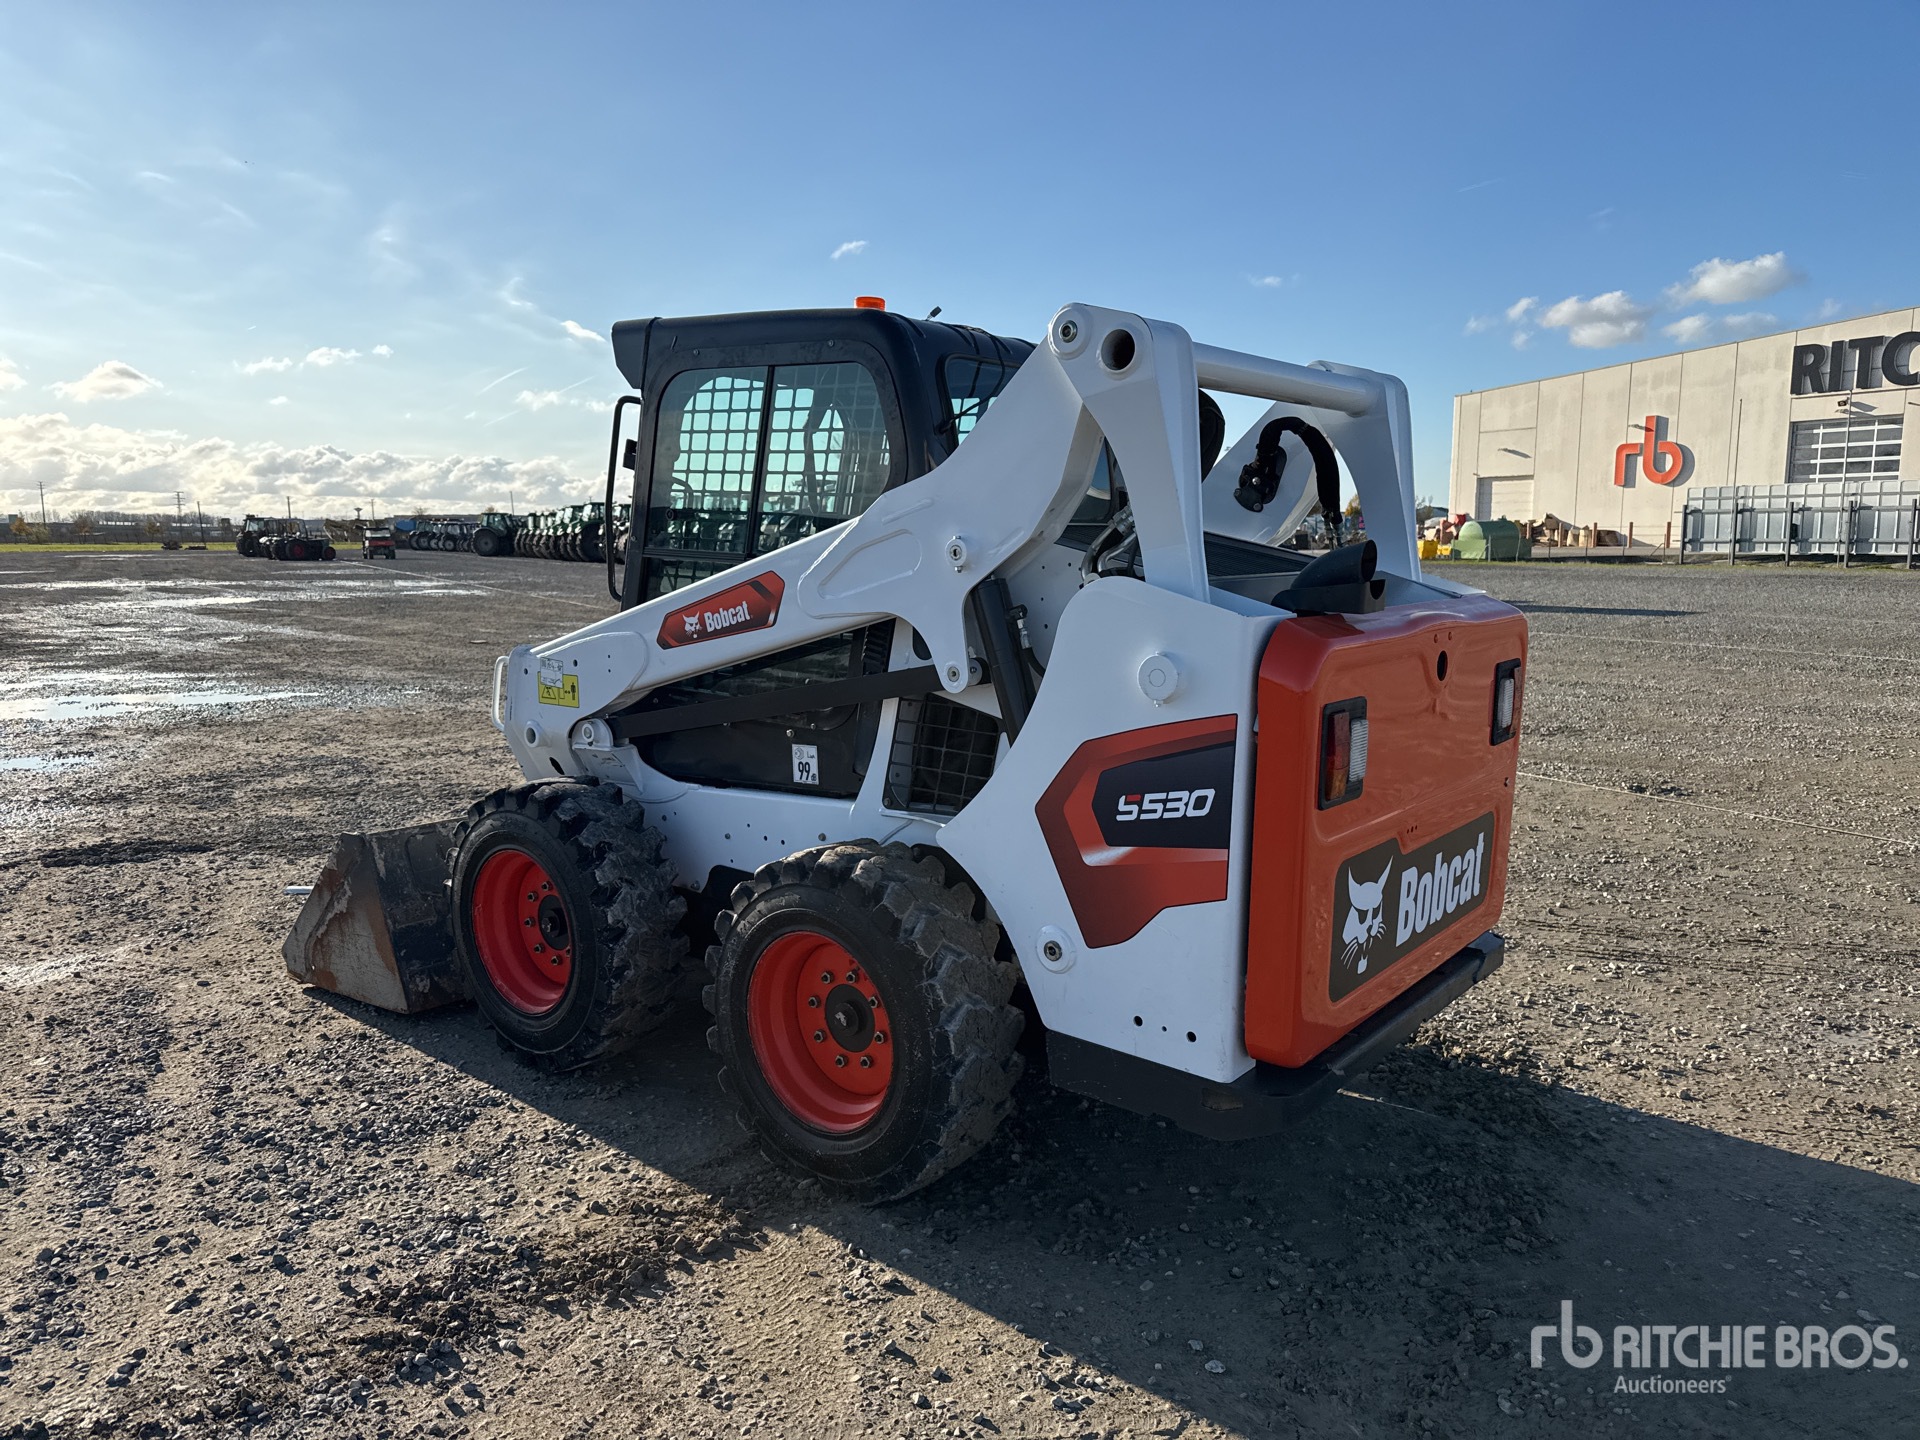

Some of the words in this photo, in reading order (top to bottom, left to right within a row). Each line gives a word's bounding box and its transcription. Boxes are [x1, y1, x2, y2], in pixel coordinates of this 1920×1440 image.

[1790, 331, 1920, 395] RITC
[1614, 415, 1683, 487] rb
[704, 601, 750, 632] Bobcat
[798, 761, 810, 780] 99
[1116, 788, 1216, 821] S530
[1396, 832, 1484, 947] Bobcat
